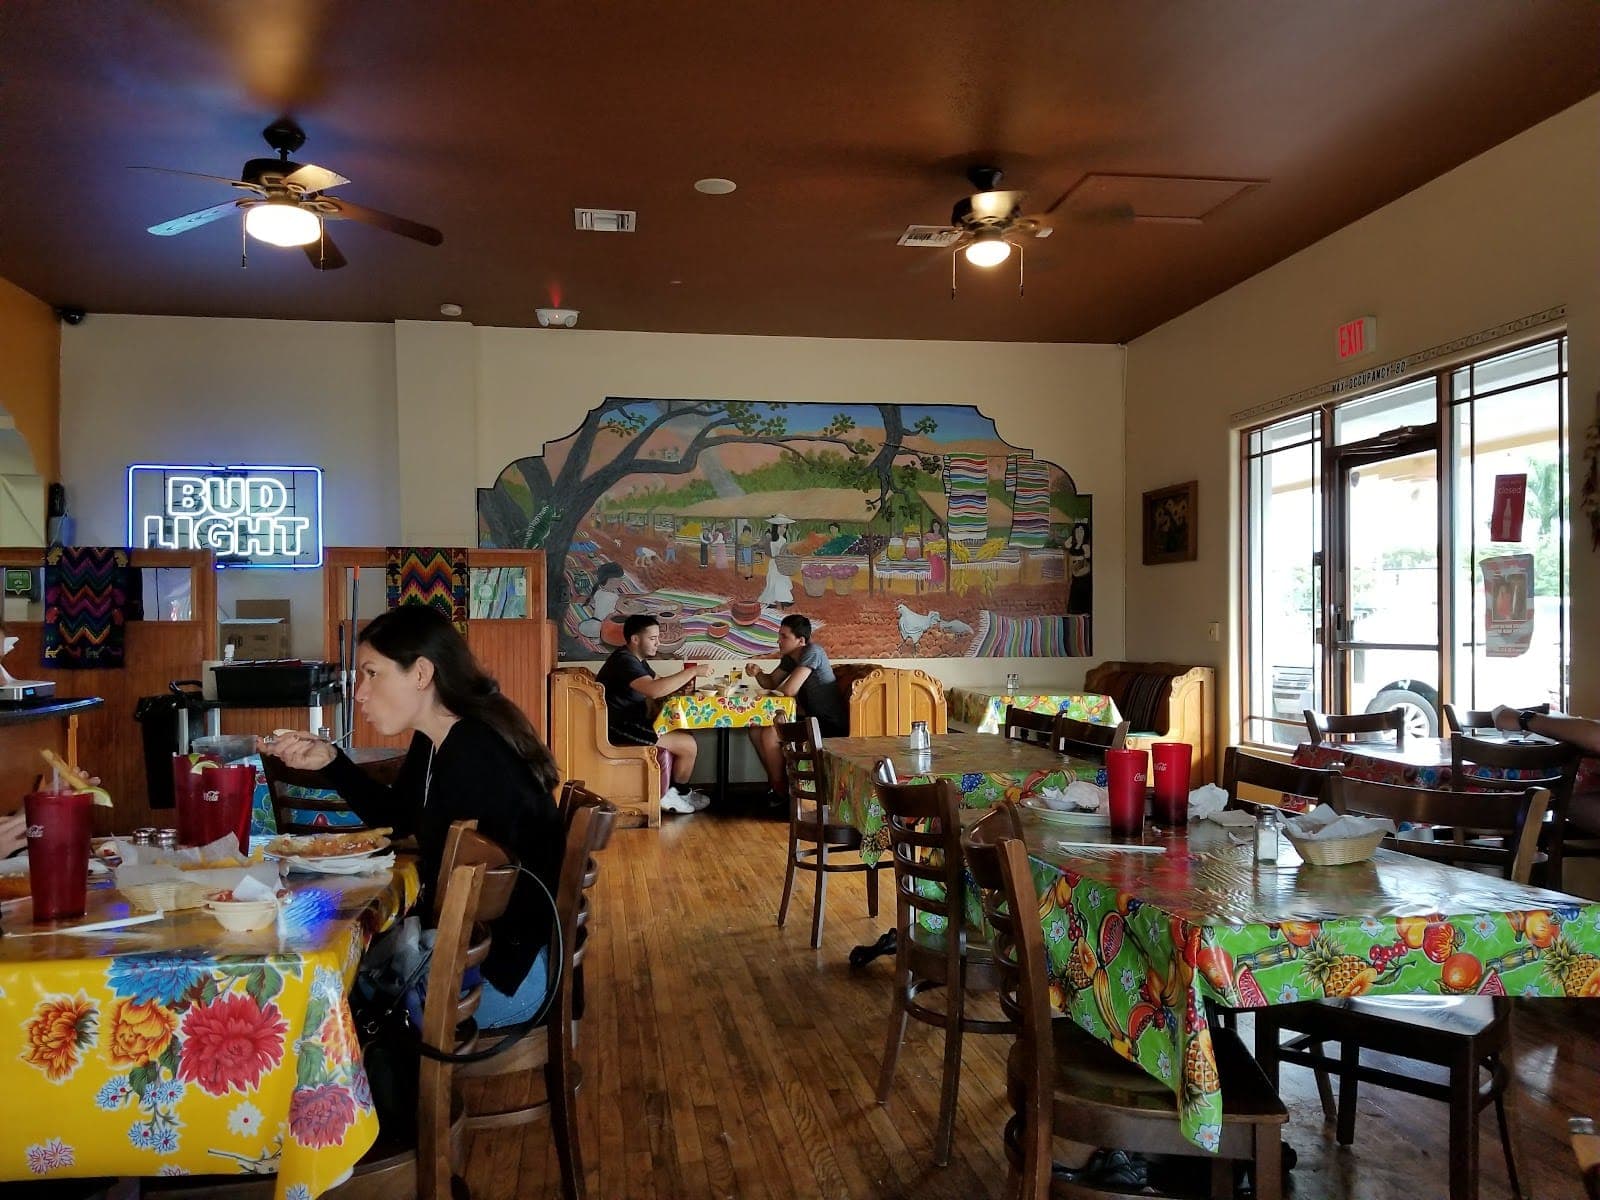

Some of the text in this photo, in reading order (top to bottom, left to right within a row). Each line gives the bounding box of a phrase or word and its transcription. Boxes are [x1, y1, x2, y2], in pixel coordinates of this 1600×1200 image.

[1338, 319, 1364, 359] EXIT
[168, 476, 288, 517] BUD
[144, 515, 310, 556] LIGHT
